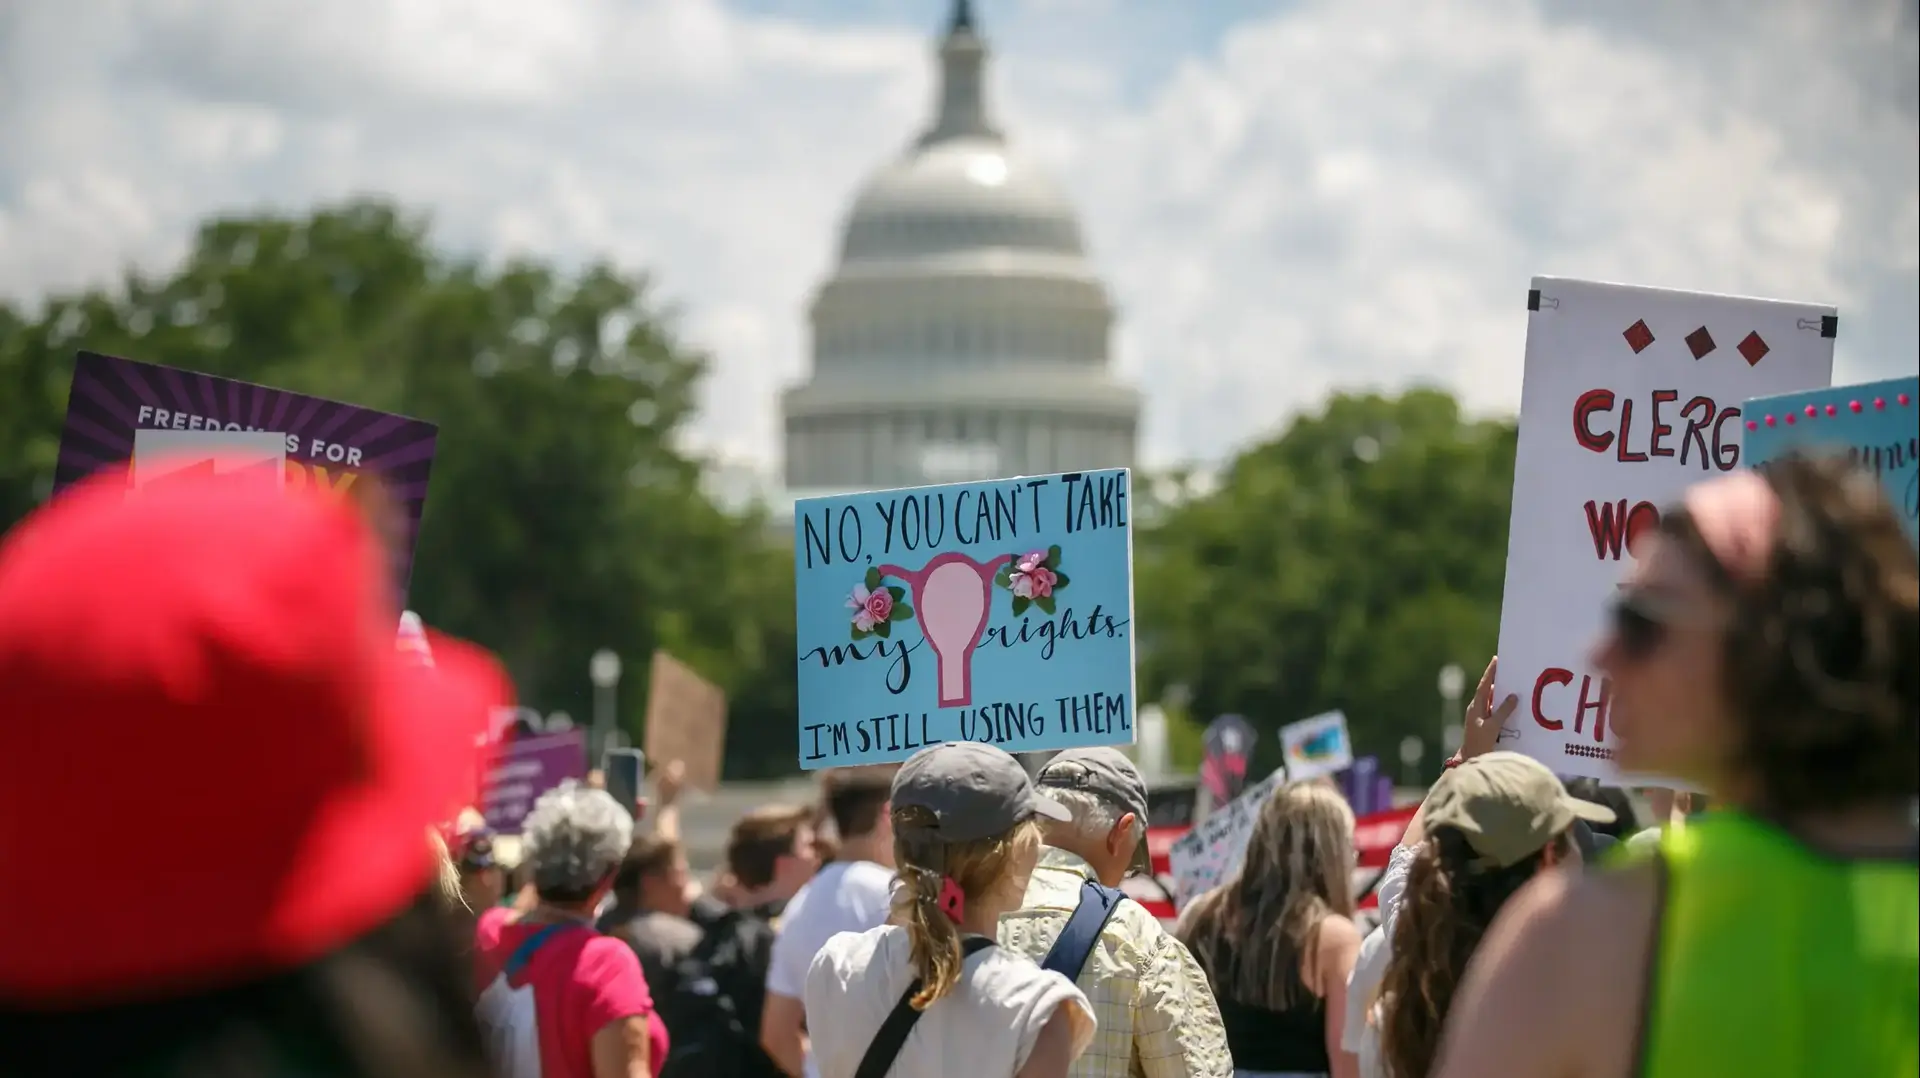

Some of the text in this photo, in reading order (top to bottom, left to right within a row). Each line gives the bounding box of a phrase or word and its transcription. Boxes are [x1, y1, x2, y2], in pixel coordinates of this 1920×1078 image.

[285, 434, 300, 453] S
[310, 439, 363, 467] FOR
[1573, 388, 1742, 471] CLERG
[804, 472, 1127, 569] NO, YOU CAN'T TAKE
[1583, 499, 1661, 561] WO
[800, 605, 1130, 694] my rights.
[804, 692, 1131, 760] I'M STILL USING THEM.
[1531, 667, 1612, 743] CH
